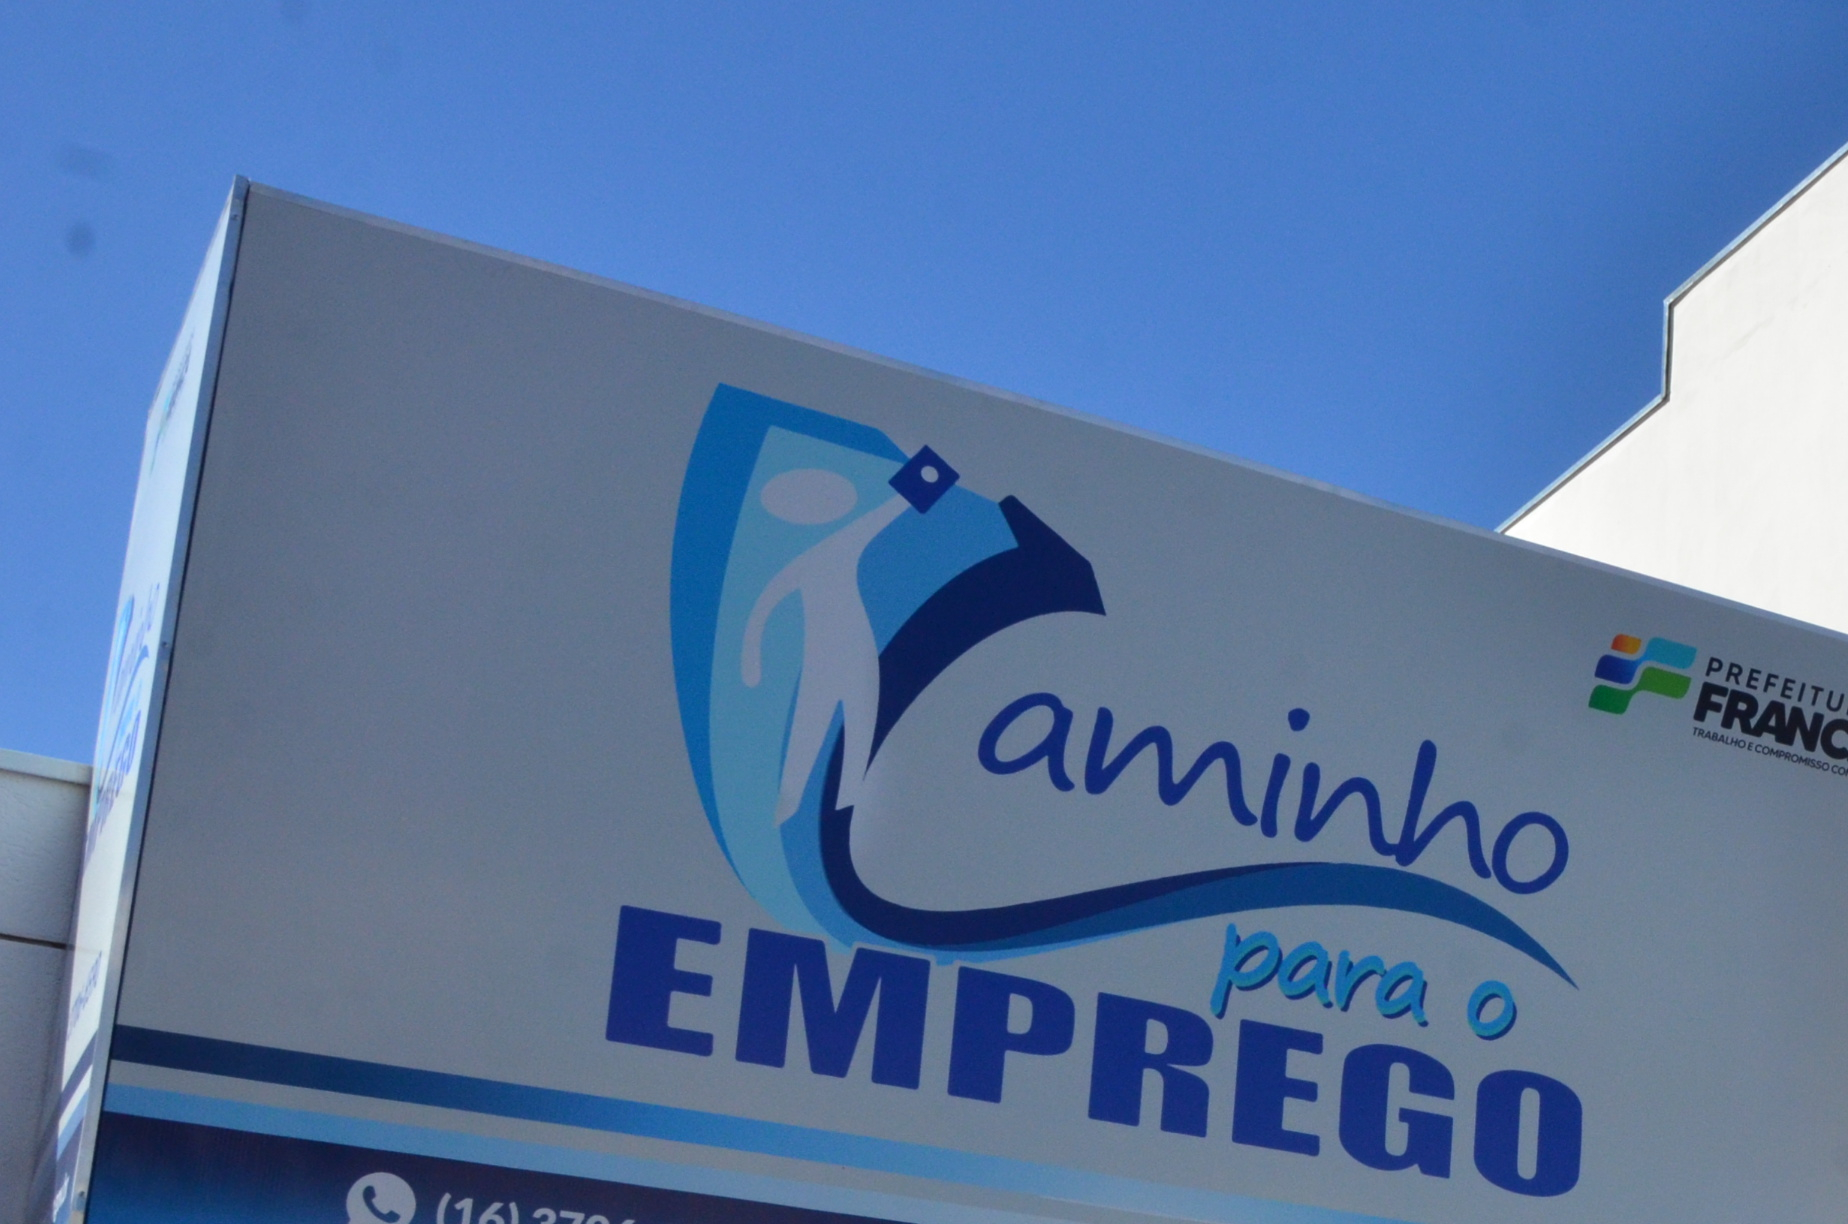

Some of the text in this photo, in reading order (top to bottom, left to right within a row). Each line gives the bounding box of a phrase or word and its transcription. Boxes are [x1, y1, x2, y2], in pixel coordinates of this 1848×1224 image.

[1692, 727, 1746, 749] TRABALHO
[1747, 741, 1754, 751] E
[1754, 743, 1830, 772] COMPROMISSO
[1210, 921, 1518, 1042] para o
[604, 903, 1584, 1198] EMPREGO
